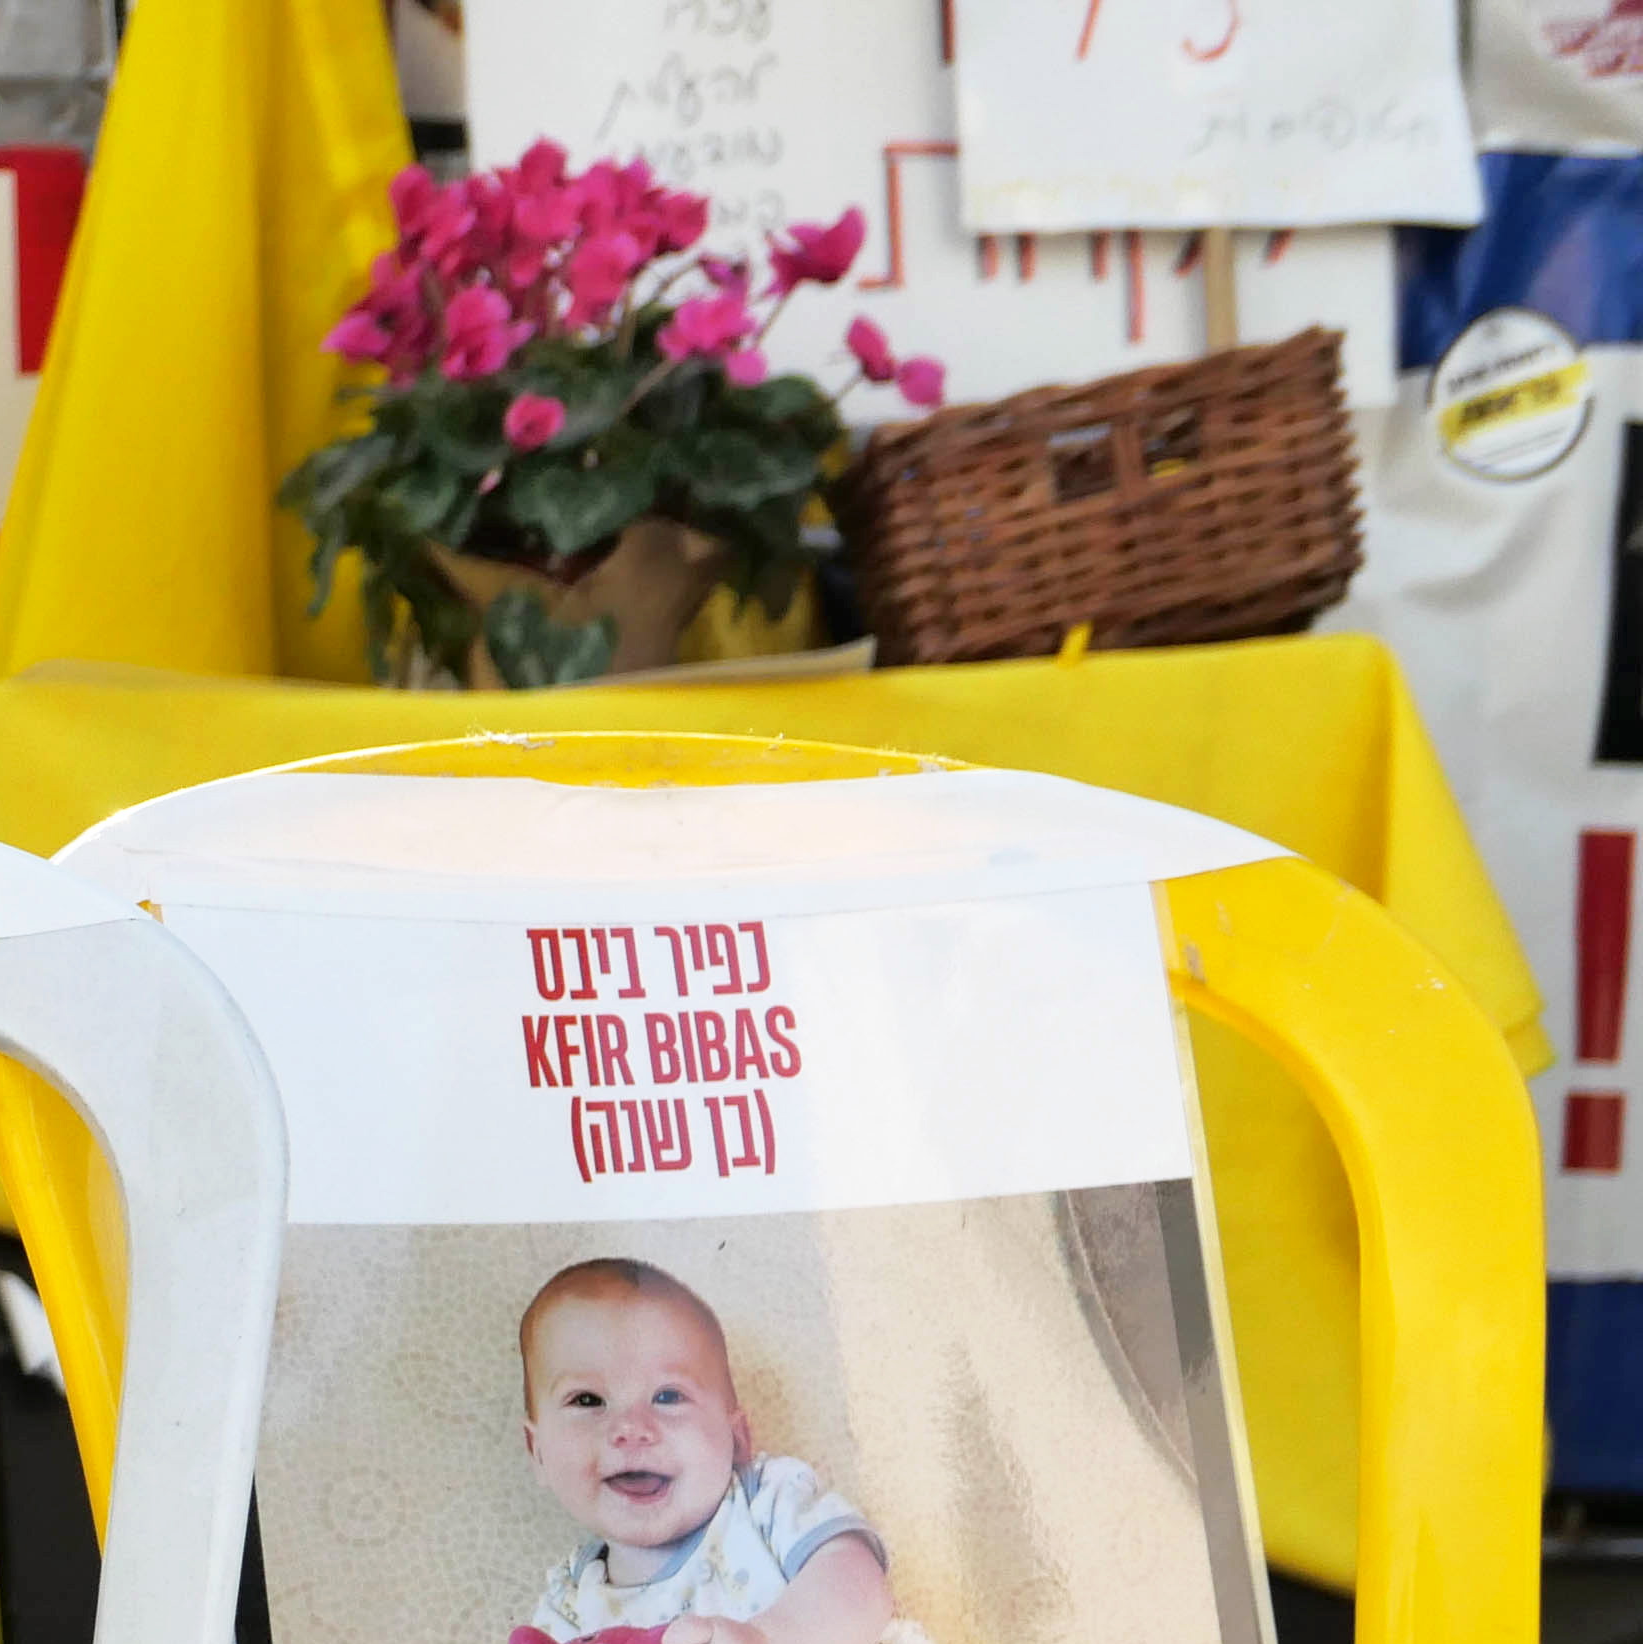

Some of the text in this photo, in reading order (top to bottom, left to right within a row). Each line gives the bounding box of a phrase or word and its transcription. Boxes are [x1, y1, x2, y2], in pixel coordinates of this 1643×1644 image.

[526, 920, 772, 1002] כפיר ביבס
[521, 1004, 803, 1089] KFIR BIBAS
